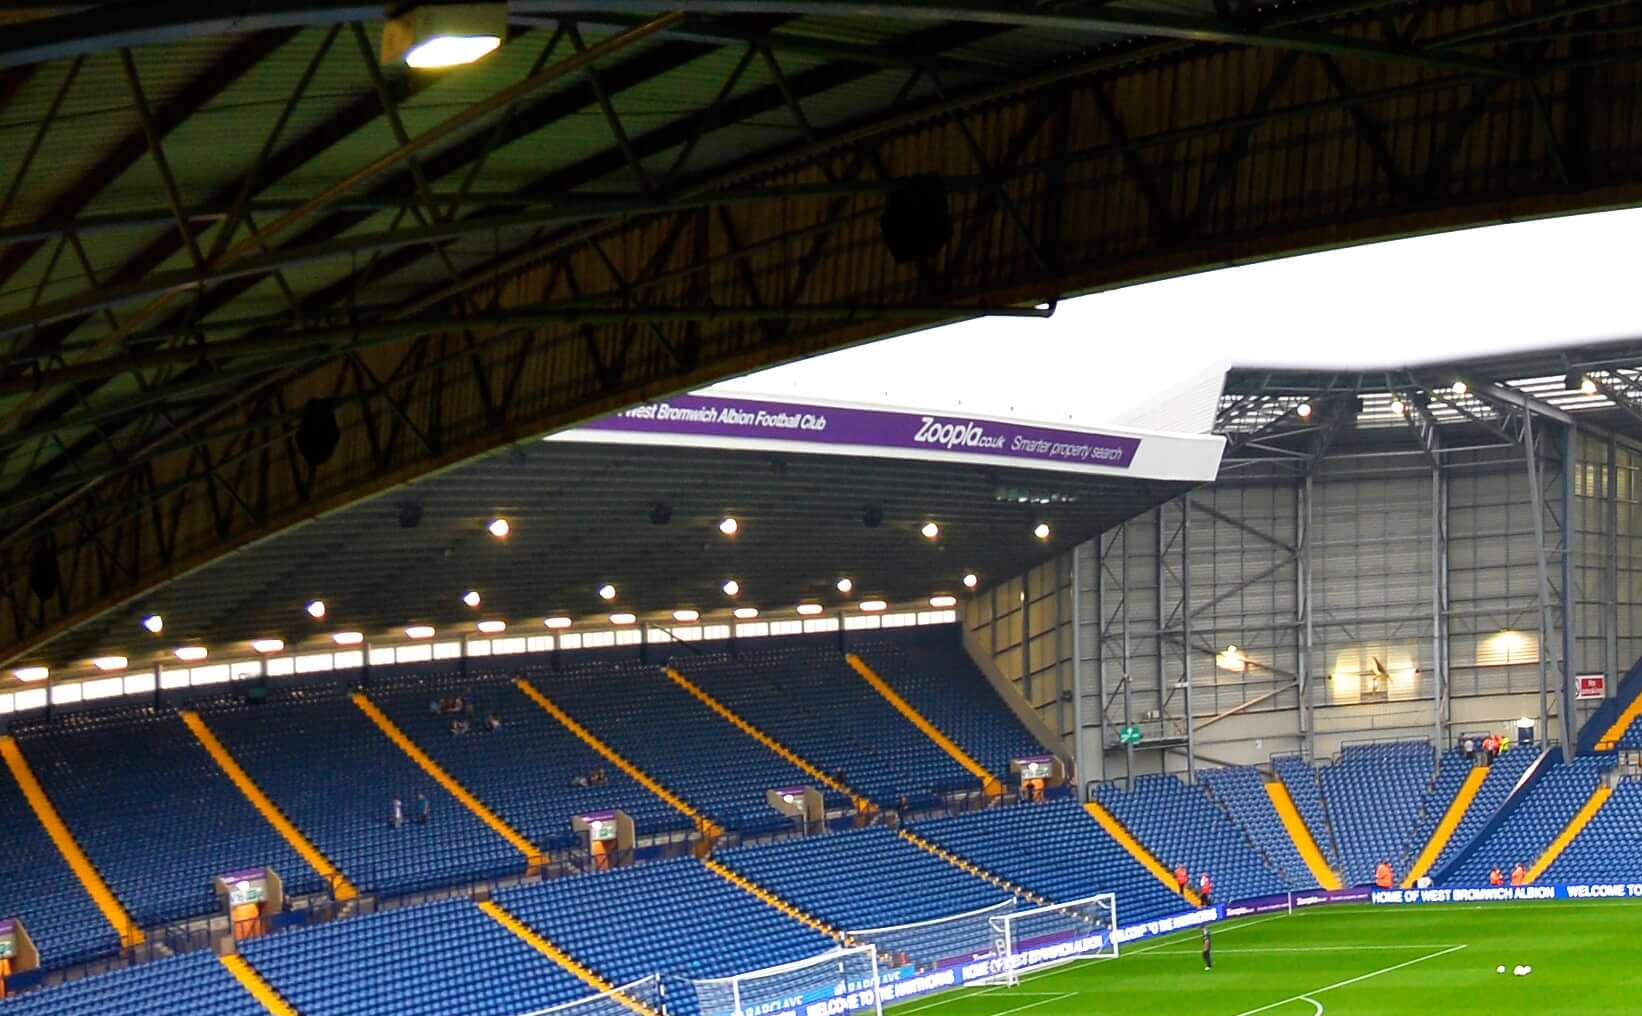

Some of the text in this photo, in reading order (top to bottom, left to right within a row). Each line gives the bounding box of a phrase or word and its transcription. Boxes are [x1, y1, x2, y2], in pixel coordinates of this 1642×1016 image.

[657, 404, 717, 422] Bromwich
[718, 411, 754, 425] Albion
[755, 411, 802, 428] Football
[801, 415, 826, 430] Club
[1011, 435, 1051, 453] Smarter
[1049, 441, 1090, 460] property
[1091, 446, 1122, 460] search
[1372, 890, 1403, 904] HOME
[1404, 890, 1420, 902] OF
[1420, 889, 1451, 902] WEST
[1453, 887, 1513, 901] BROMWICH
[1514, 886, 1555, 899] ALBION
[1567, 885, 1625, 898] WELCOME
[1627, 885, 1642, 896] TO
[1174, 908, 1217, 929] HAWTHORNS
[962, 961, 989, 980] HOME
[860, 990, 874, 1008] TO
[895, 970, 954, 997] HAWTHORNS
